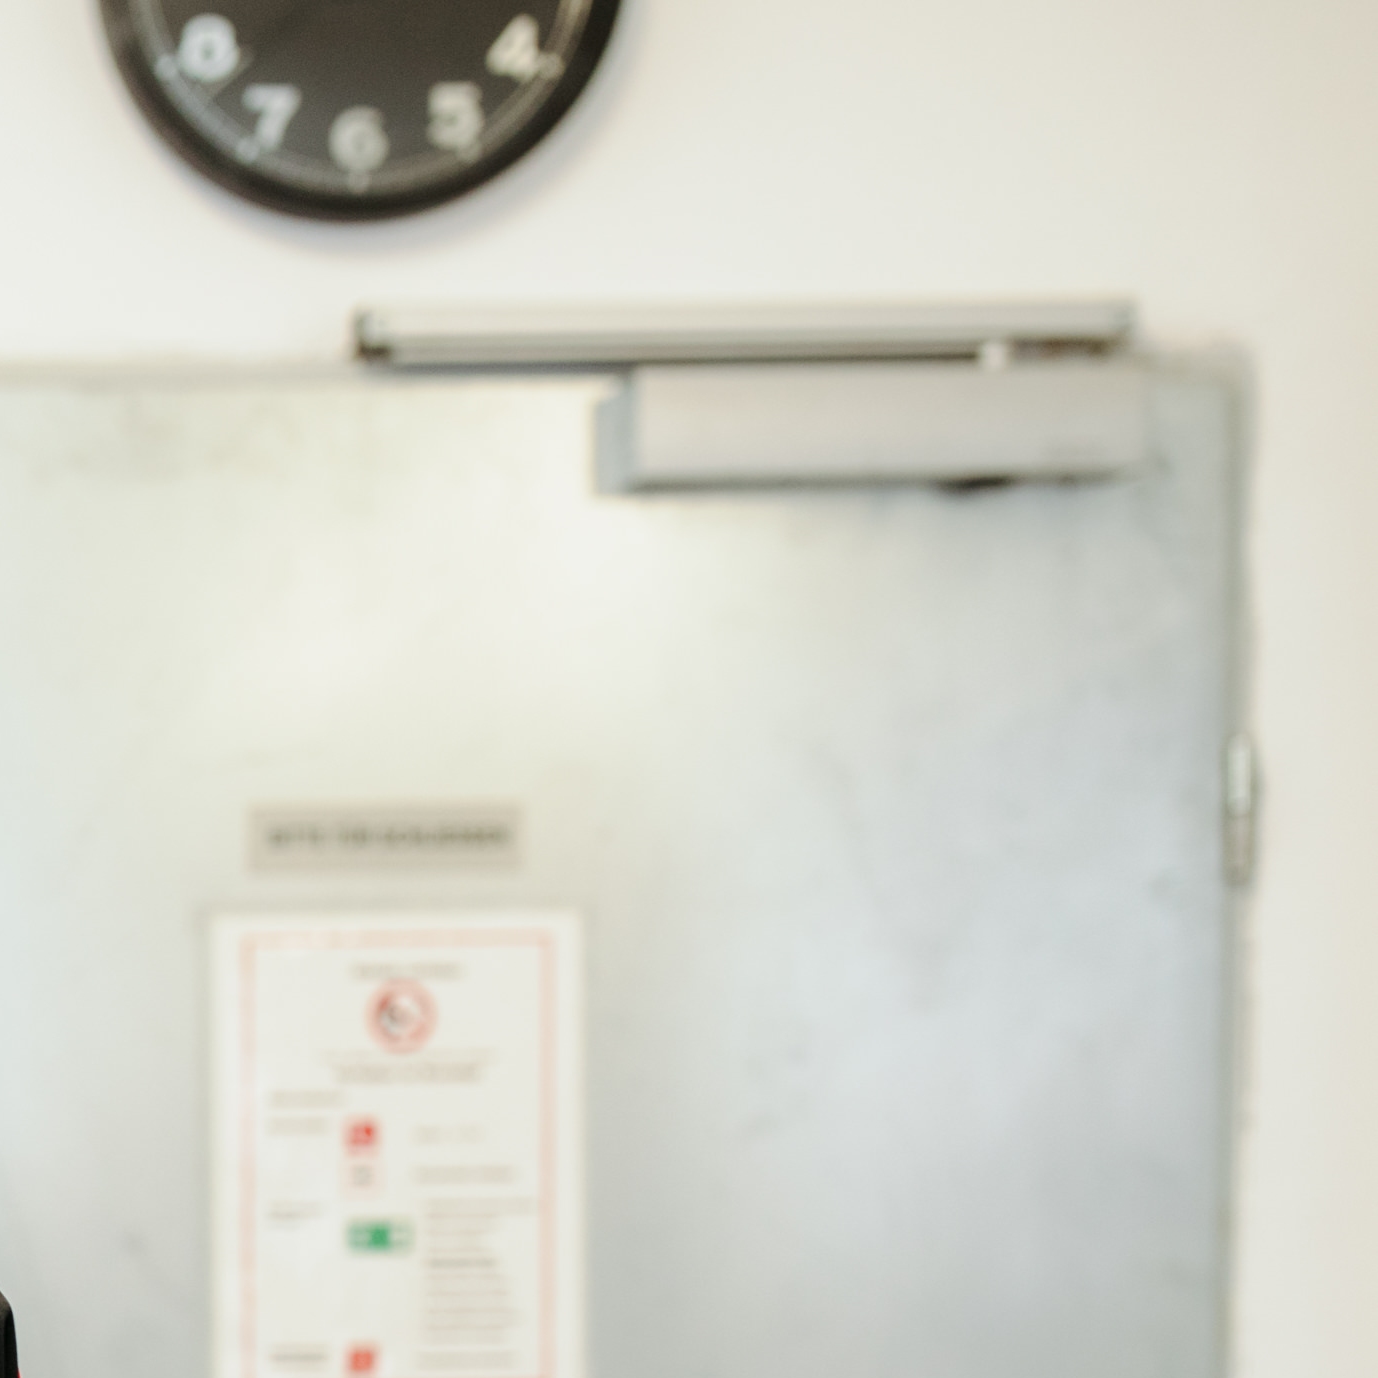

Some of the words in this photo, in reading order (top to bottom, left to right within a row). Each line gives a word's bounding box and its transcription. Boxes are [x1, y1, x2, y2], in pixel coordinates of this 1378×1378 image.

[485, 13, 540, 80] 4
[242, 83, 301, 152] 7
[328, 106, 390, 174] 6
[427, 80, 483, 149] 5
